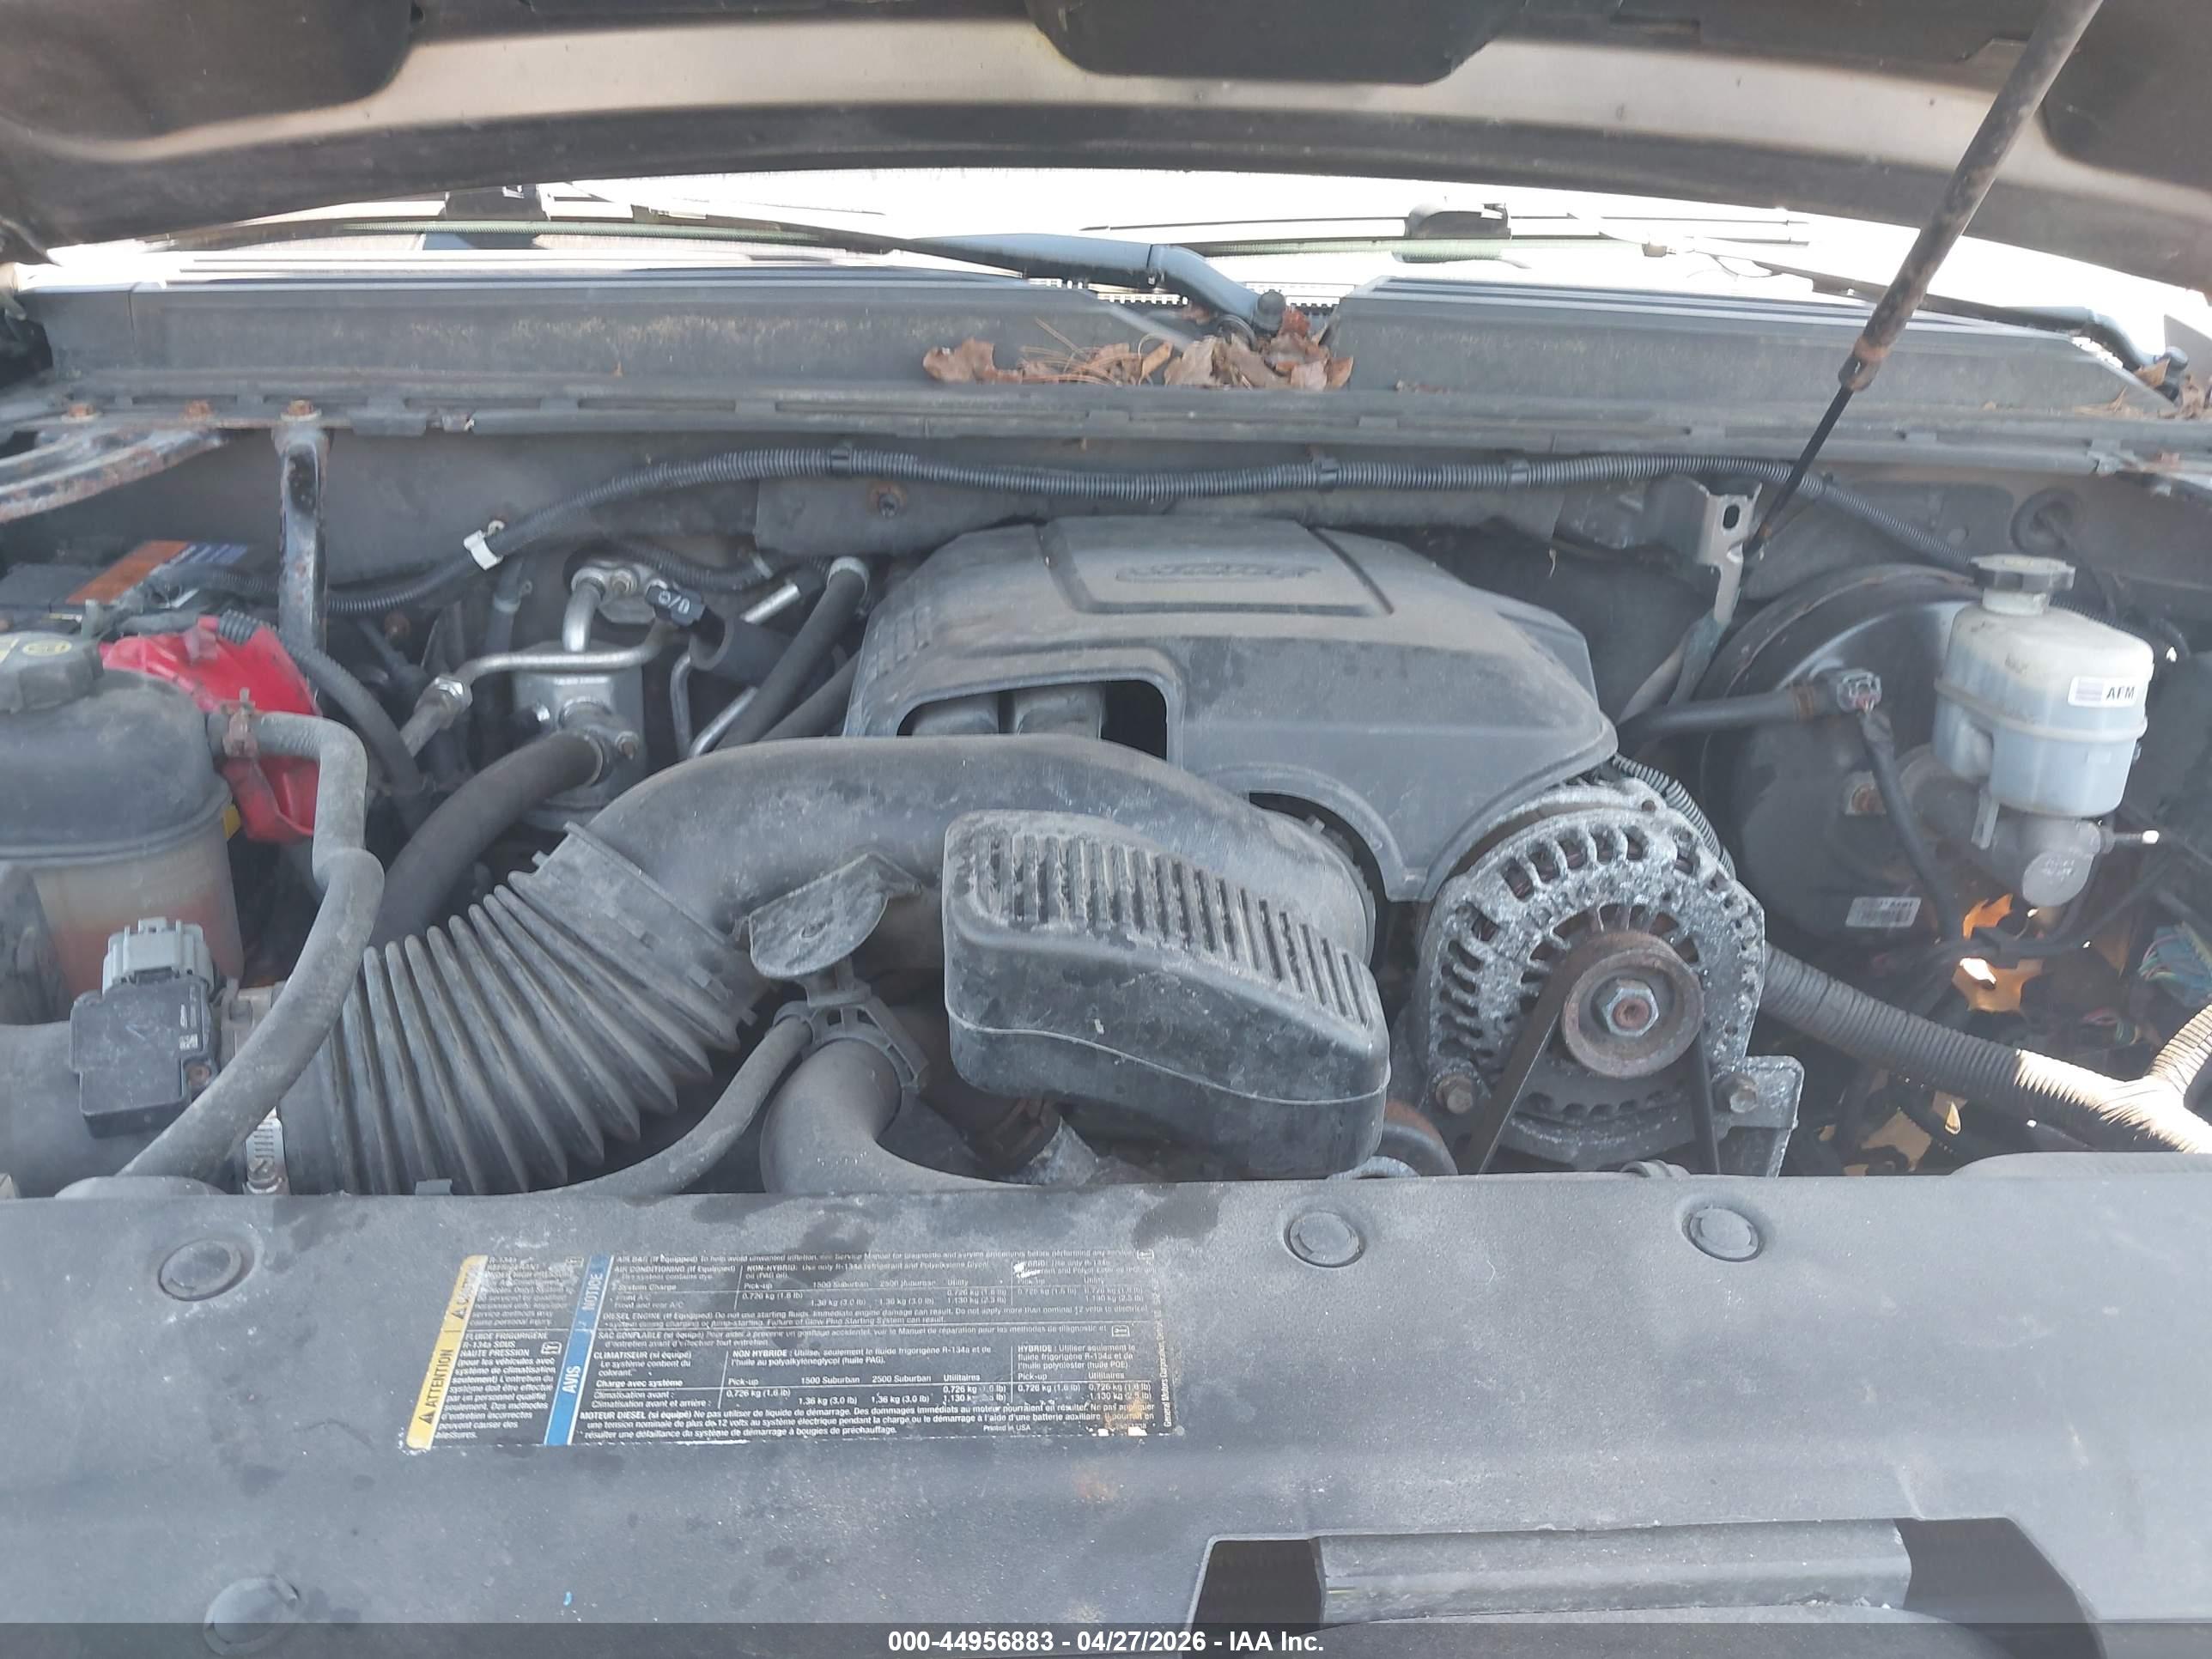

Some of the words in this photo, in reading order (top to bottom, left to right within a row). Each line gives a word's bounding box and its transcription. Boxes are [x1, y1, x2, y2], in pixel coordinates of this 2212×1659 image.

[581, 1272, 602, 1312] NOTICE
[661, 1351, 692, 1359] équipé)
[898, 1346, 940, 1355] frigorigène
[611, 1360, 645, 1369] système
[865, 1356, 886, 1364] PAG).
[455, 1367, 489, 1376] système
[426, 1349, 453, 1408] ATTENTION
[562, 1365, 581, 1394] AVIS
[728, 1378, 758, 1387] Pick-up
[943, 1374, 981, 1382] Utilitaires
[596, 1380, 625, 1389] Charge
[648, 1379, 683, 1389] système
[996, 1384, 1006, 1393] lb)
[1071, 1383, 1081, 1392] lb)
[449, 1385, 483, 1394] système
[780, 1388, 791, 1397] lb)
[1160, 1377, 1170, 1401] Motors
[474, 1394, 514, 1402] personnel
[516, 1393, 546, 1401] qualifié
[593, 1391, 645, 1400] Climatisation
[919, 1395, 930, 1404] lb)
[996, 1394, 1006, 1402] lb)
[592, 1400, 644, 1408] Climatisation
[847, 1397, 858, 1406] lb)
[580, 1412, 616, 1420] MOTEUR
[648, 1412, 659, 1420] (si
[660, 1411, 692, 1420] équipé)
[765, 1409, 793, 1418] liquide
[806, 1408, 851, 1418] démarrage.
[871, 1407, 915, 1416] dommages
[1162, 1402, 1172, 1427] General
[686, 1420, 703, 1429] plus
[762, 1418, 796, 1427] système
[797, 1417, 836, 1426] électrique
[838, 1416, 871, 1425] pendant
[882, 1416, 909, 1425] charge
[933, 1414, 975, 1424] démarrage
[1008, 1413, 1030, 1422] d'une
[1032, 1413, 1062, 1421] batterie
[635, 1429, 680, 1438] défaillance
[694, 1429, 729, 1438] système
[743, 1428, 787, 1437] démarrage
[796, 1427, 828, 1437] bougies
[842, 1425, 896, 1436] préchauffage.
